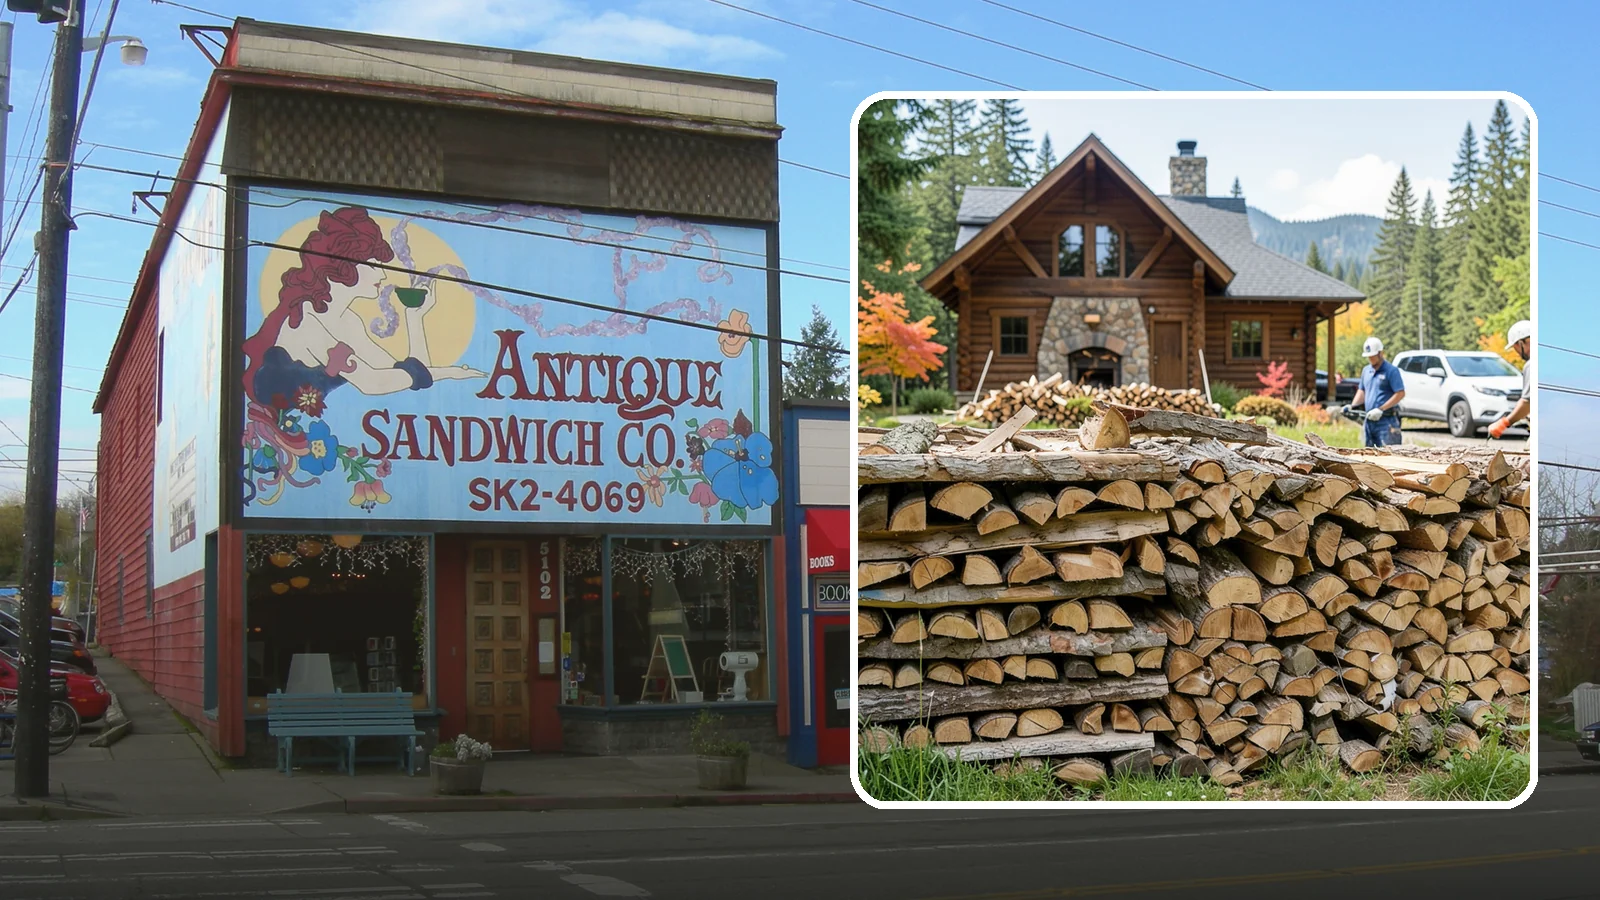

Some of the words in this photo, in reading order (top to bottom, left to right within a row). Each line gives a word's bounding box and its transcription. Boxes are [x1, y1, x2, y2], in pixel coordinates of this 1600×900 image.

[476, 329, 724, 421] ANTIQUE
[361, 408, 605, 467] SANDWICH
[617, 421, 685, 469] CO.
[468, 477, 646, 513] SK2-4069
[540, 543, 551, 599] 5102
[809, 555, 834, 569] BOOKS
